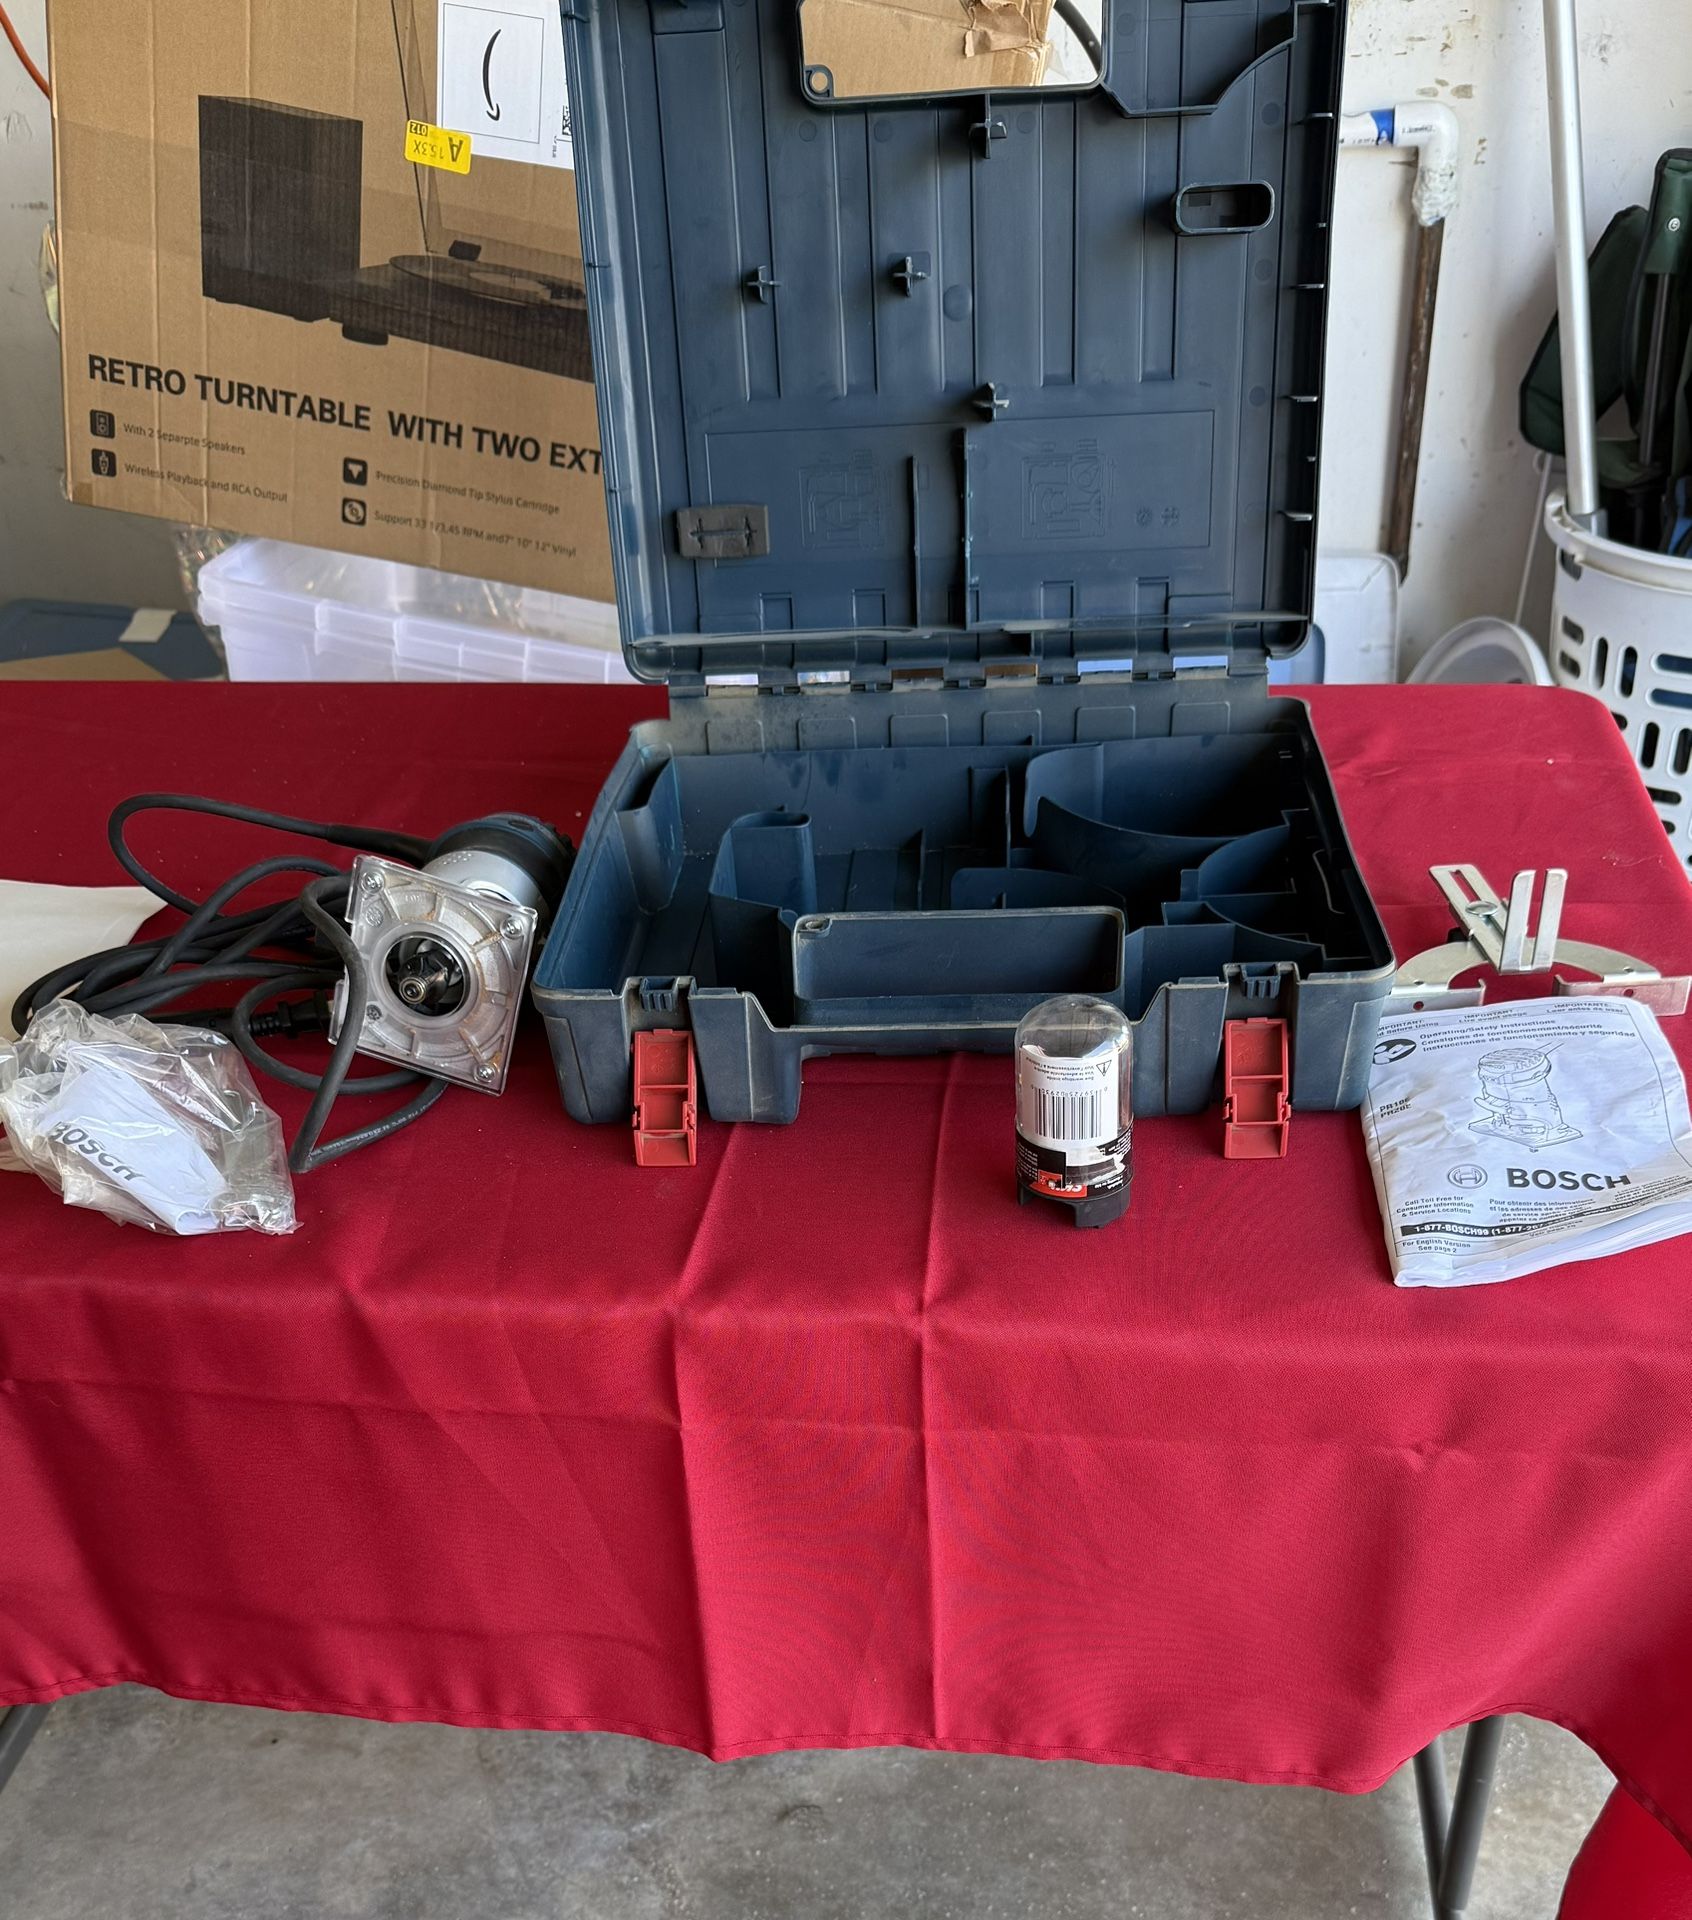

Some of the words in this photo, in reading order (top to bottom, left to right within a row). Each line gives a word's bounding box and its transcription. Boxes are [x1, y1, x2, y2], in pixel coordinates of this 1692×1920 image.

[411, 122, 428, 136] 012
[88, 354, 186, 395] RETRO
[194, 374, 371, 431] TURNTABLE
[388, 410, 463, 449] WITH
[472, 426, 541, 463] TWO
[123, 423, 147, 437] With
[148, 428, 155, 438] 2
[201, 437, 246, 456] Speakers
[124, 463, 166, 481] Wireless
[166, 470, 209, 488] Playback
[210, 480, 229, 493] and
[231, 483, 252, 497] RCA
[253, 487, 288, 503] Output
[375, 470, 420, 488] Precision
[422, 479, 467, 497] Diamond
[468, 486, 484, 500] Tip
[485, 490, 514, 507] Stylus
[515, 496, 560, 514] Cartridge
[374, 510, 412, 527] Support
[414, 517, 427, 529] 33
[462, 528, 484, 541] RPM
[552, 545, 577, 558] Vinyl
[1377, 1019, 1423, 1032] MPORTANT
[1420, 1024, 1498, 1041] Operating/Safety
[1500, 1019, 1556, 1029] Instructions
[1421, 1034, 1471, 1047] Consignes
[1422, 1040, 1487, 1052] Instrucciones
[1503, 1030, 1578, 1041] funcionamiento
[1588, 1029, 1636, 1038] seguridad
[1506, 1168, 1631, 1191] BOSCH
[1396, 1203, 1432, 1214] Consumer
[1433, 1201, 1474, 1209] Information
[1489, 1198, 1506, 1206] Pour
[1409, 1209, 1436, 1217] Service
[1414, 1224, 1489, 1236] 1-877-BOSCH99
[1444, 1240, 1471, 1248] Version
